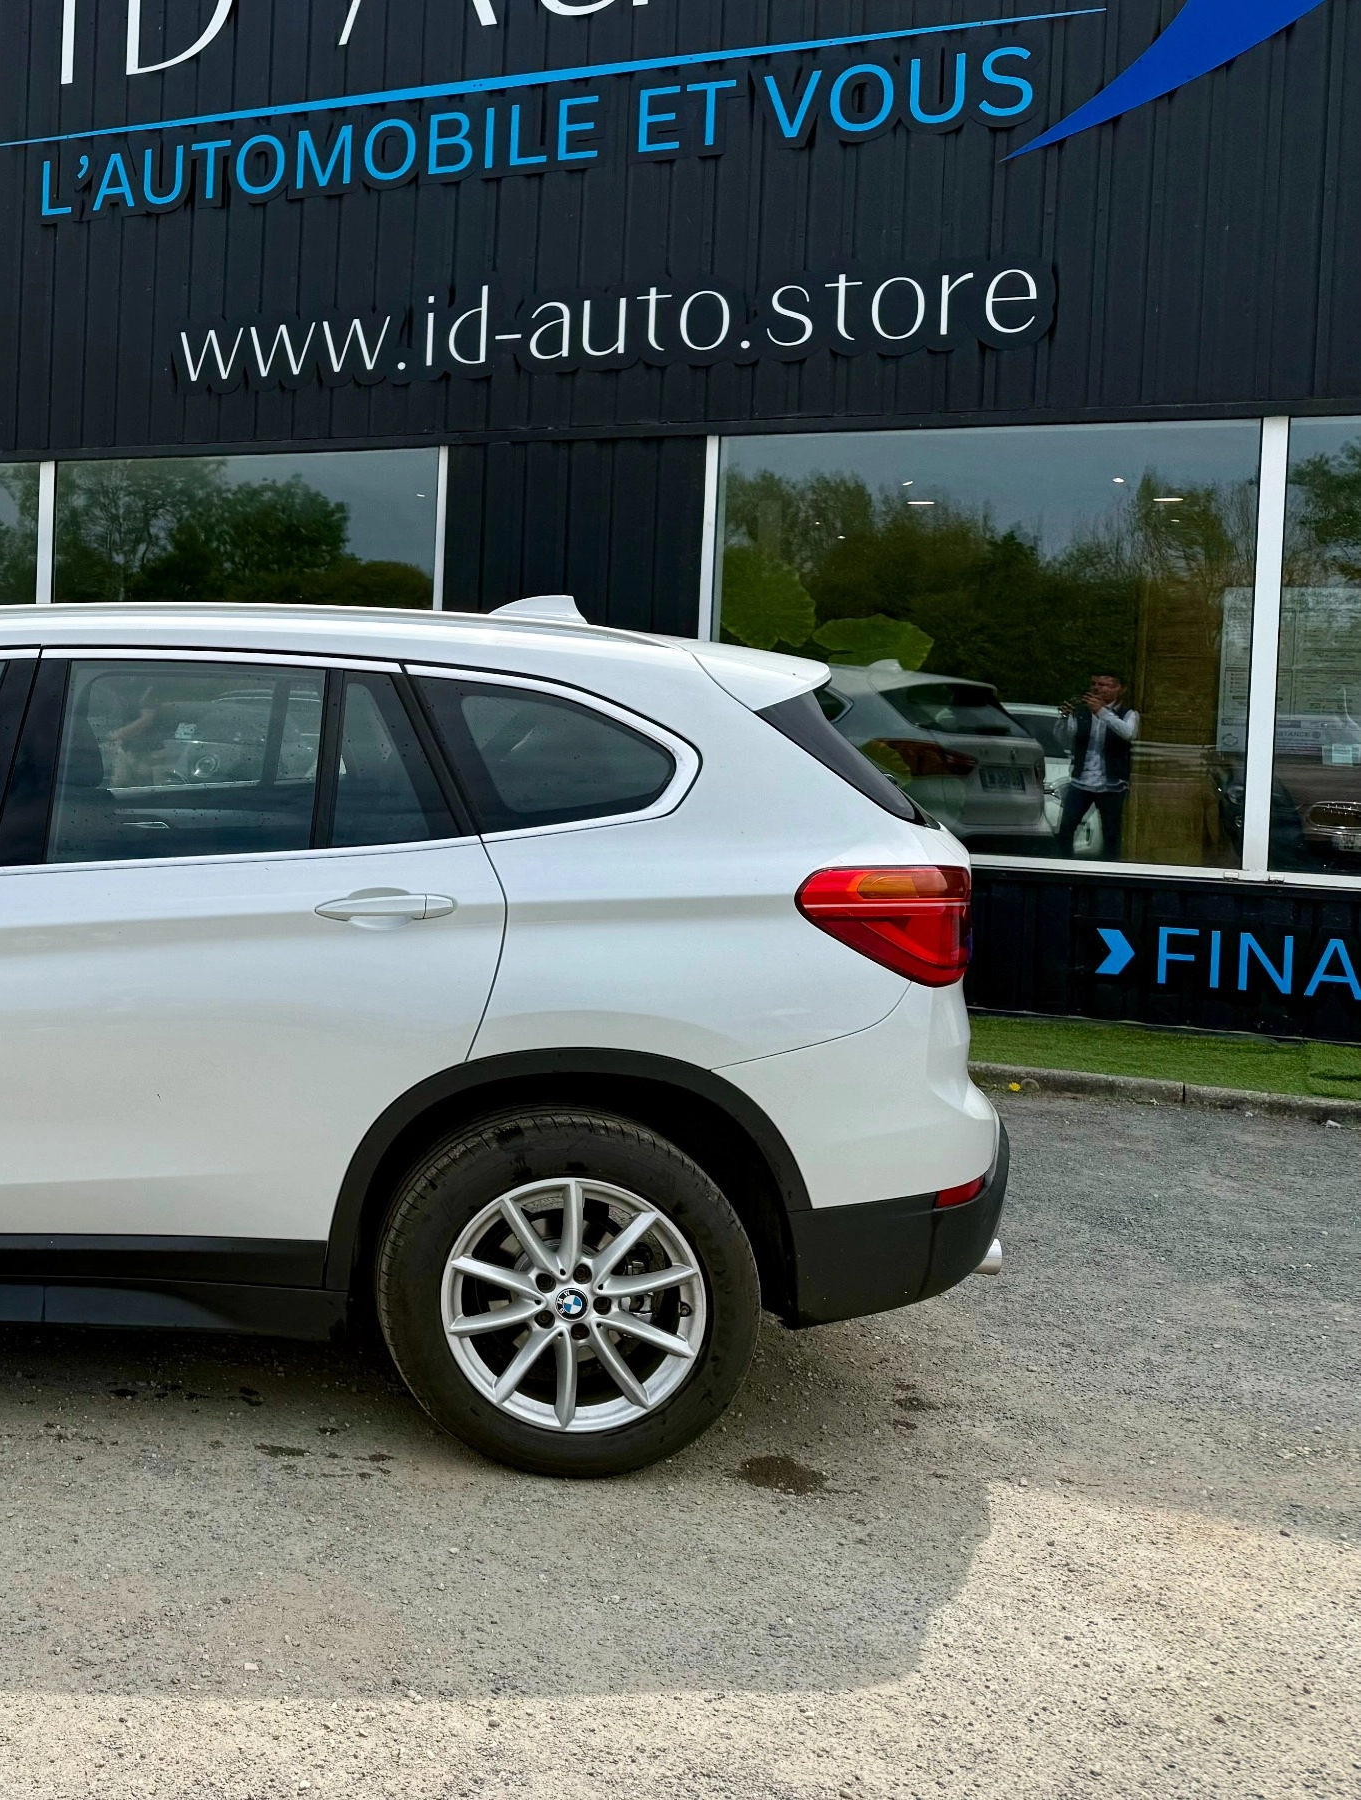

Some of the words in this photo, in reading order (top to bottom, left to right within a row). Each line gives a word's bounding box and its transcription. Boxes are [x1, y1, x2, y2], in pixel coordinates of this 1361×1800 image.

[41, 95, 599, 216] L'AUTOMOBILE
[638, 79, 737, 153] ET
[763, 46, 1034, 138] VOUS
[180, 269, 1037, 382] www.id-auto.store
